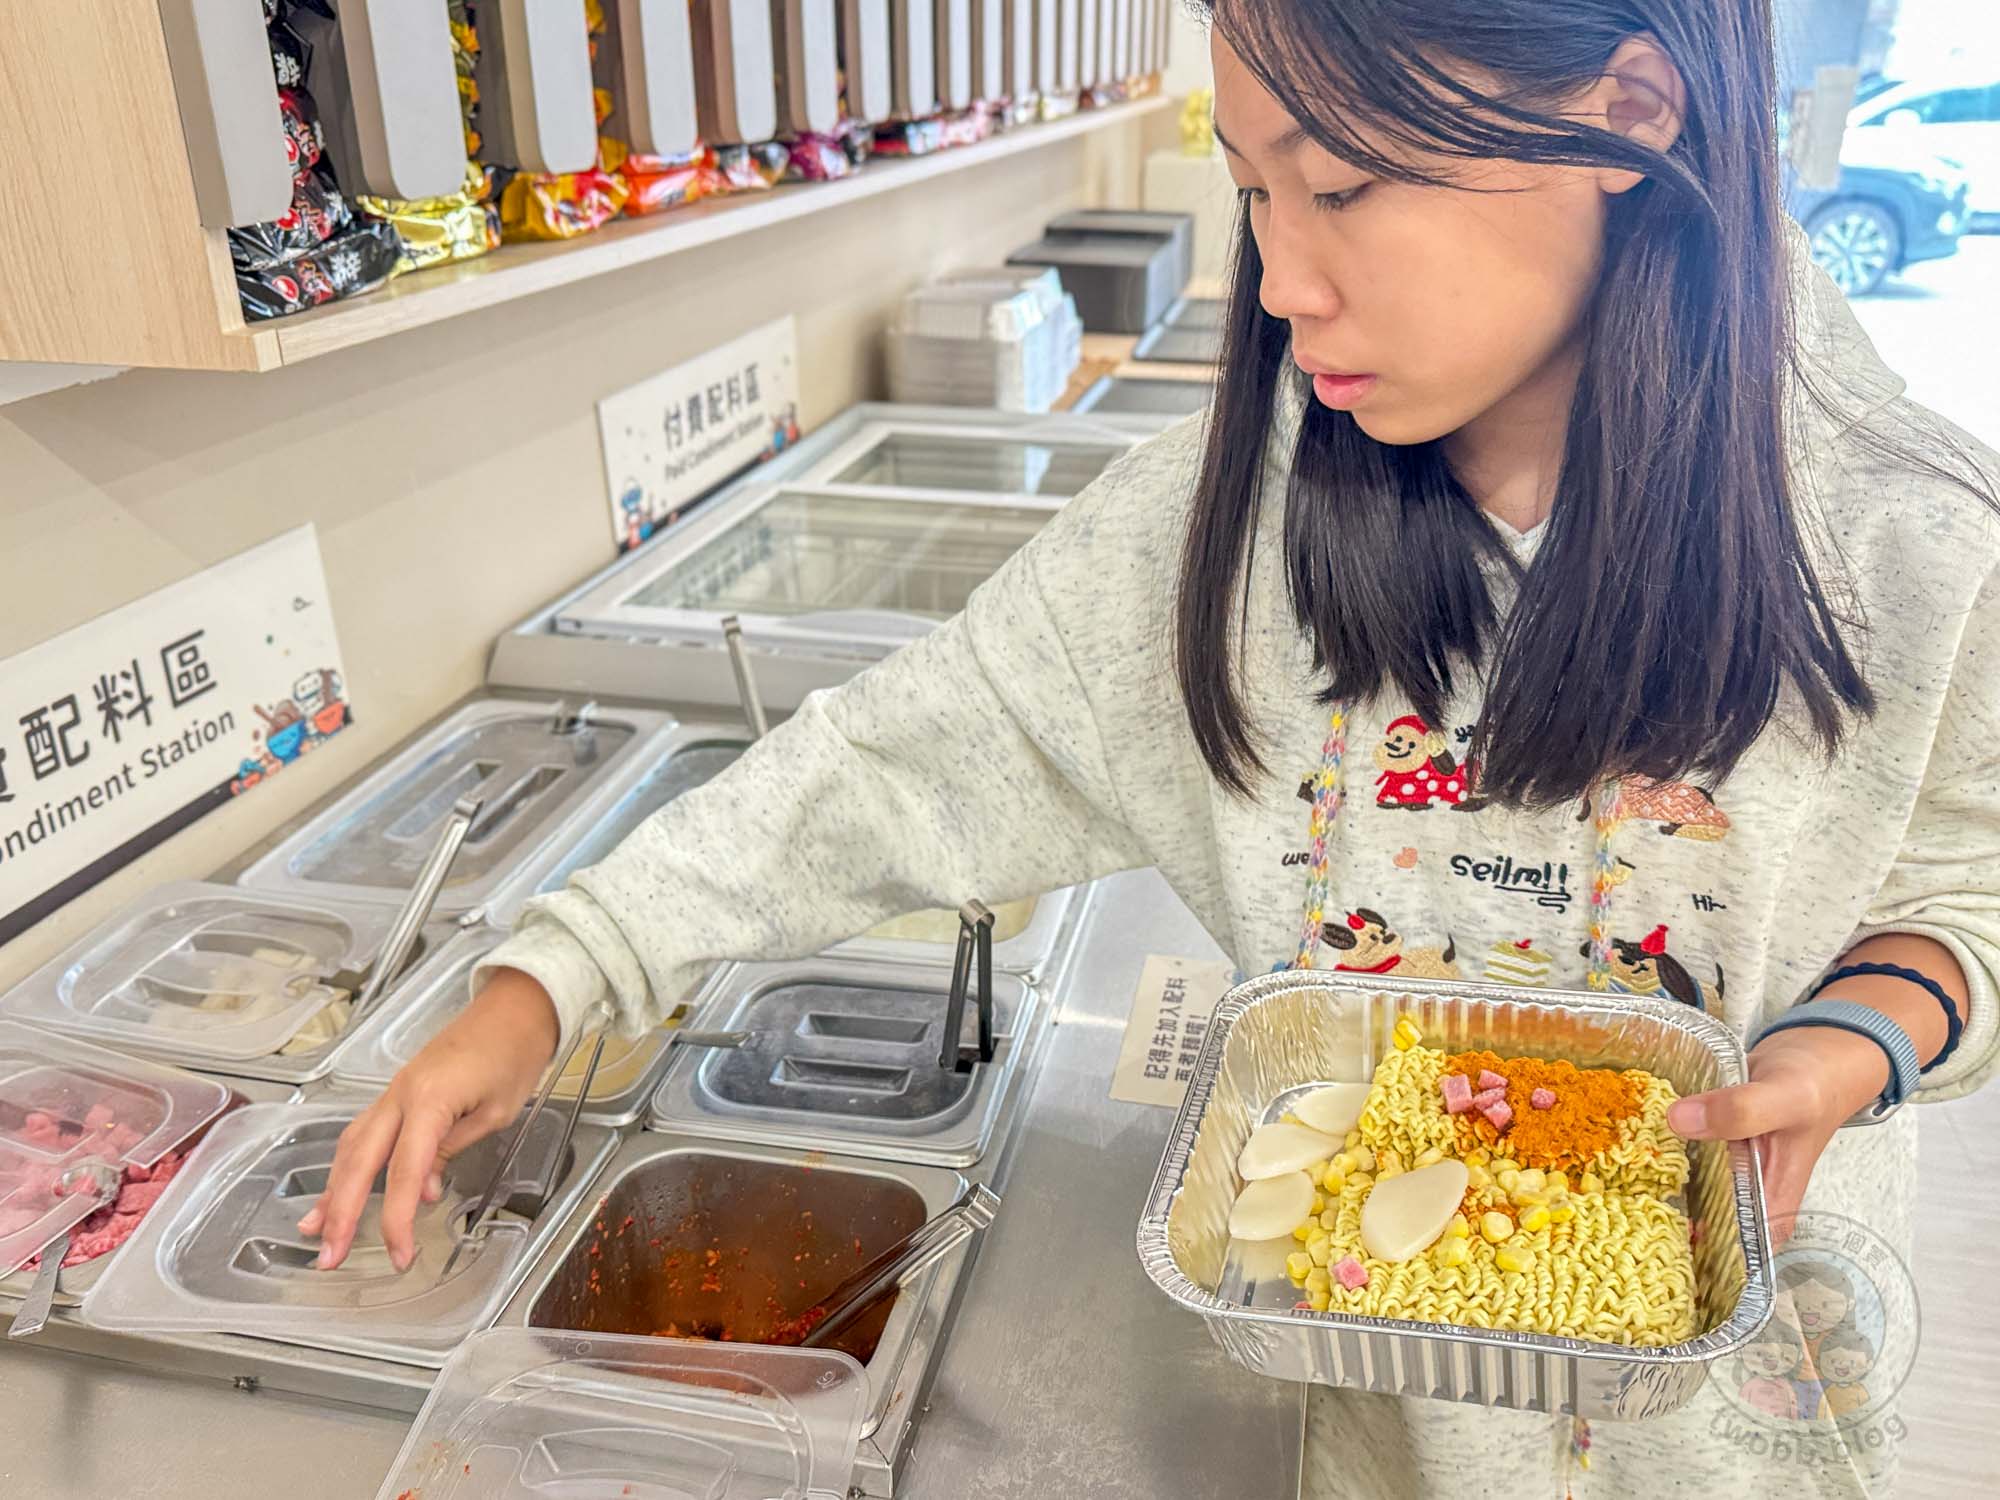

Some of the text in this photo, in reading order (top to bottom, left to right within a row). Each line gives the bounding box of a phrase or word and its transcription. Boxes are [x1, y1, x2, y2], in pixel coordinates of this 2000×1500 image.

[664, 363, 760, 450] 付費配料區
[0, 630, 217, 802] 配料區
[0, 710, 236, 864] ndiment Station
